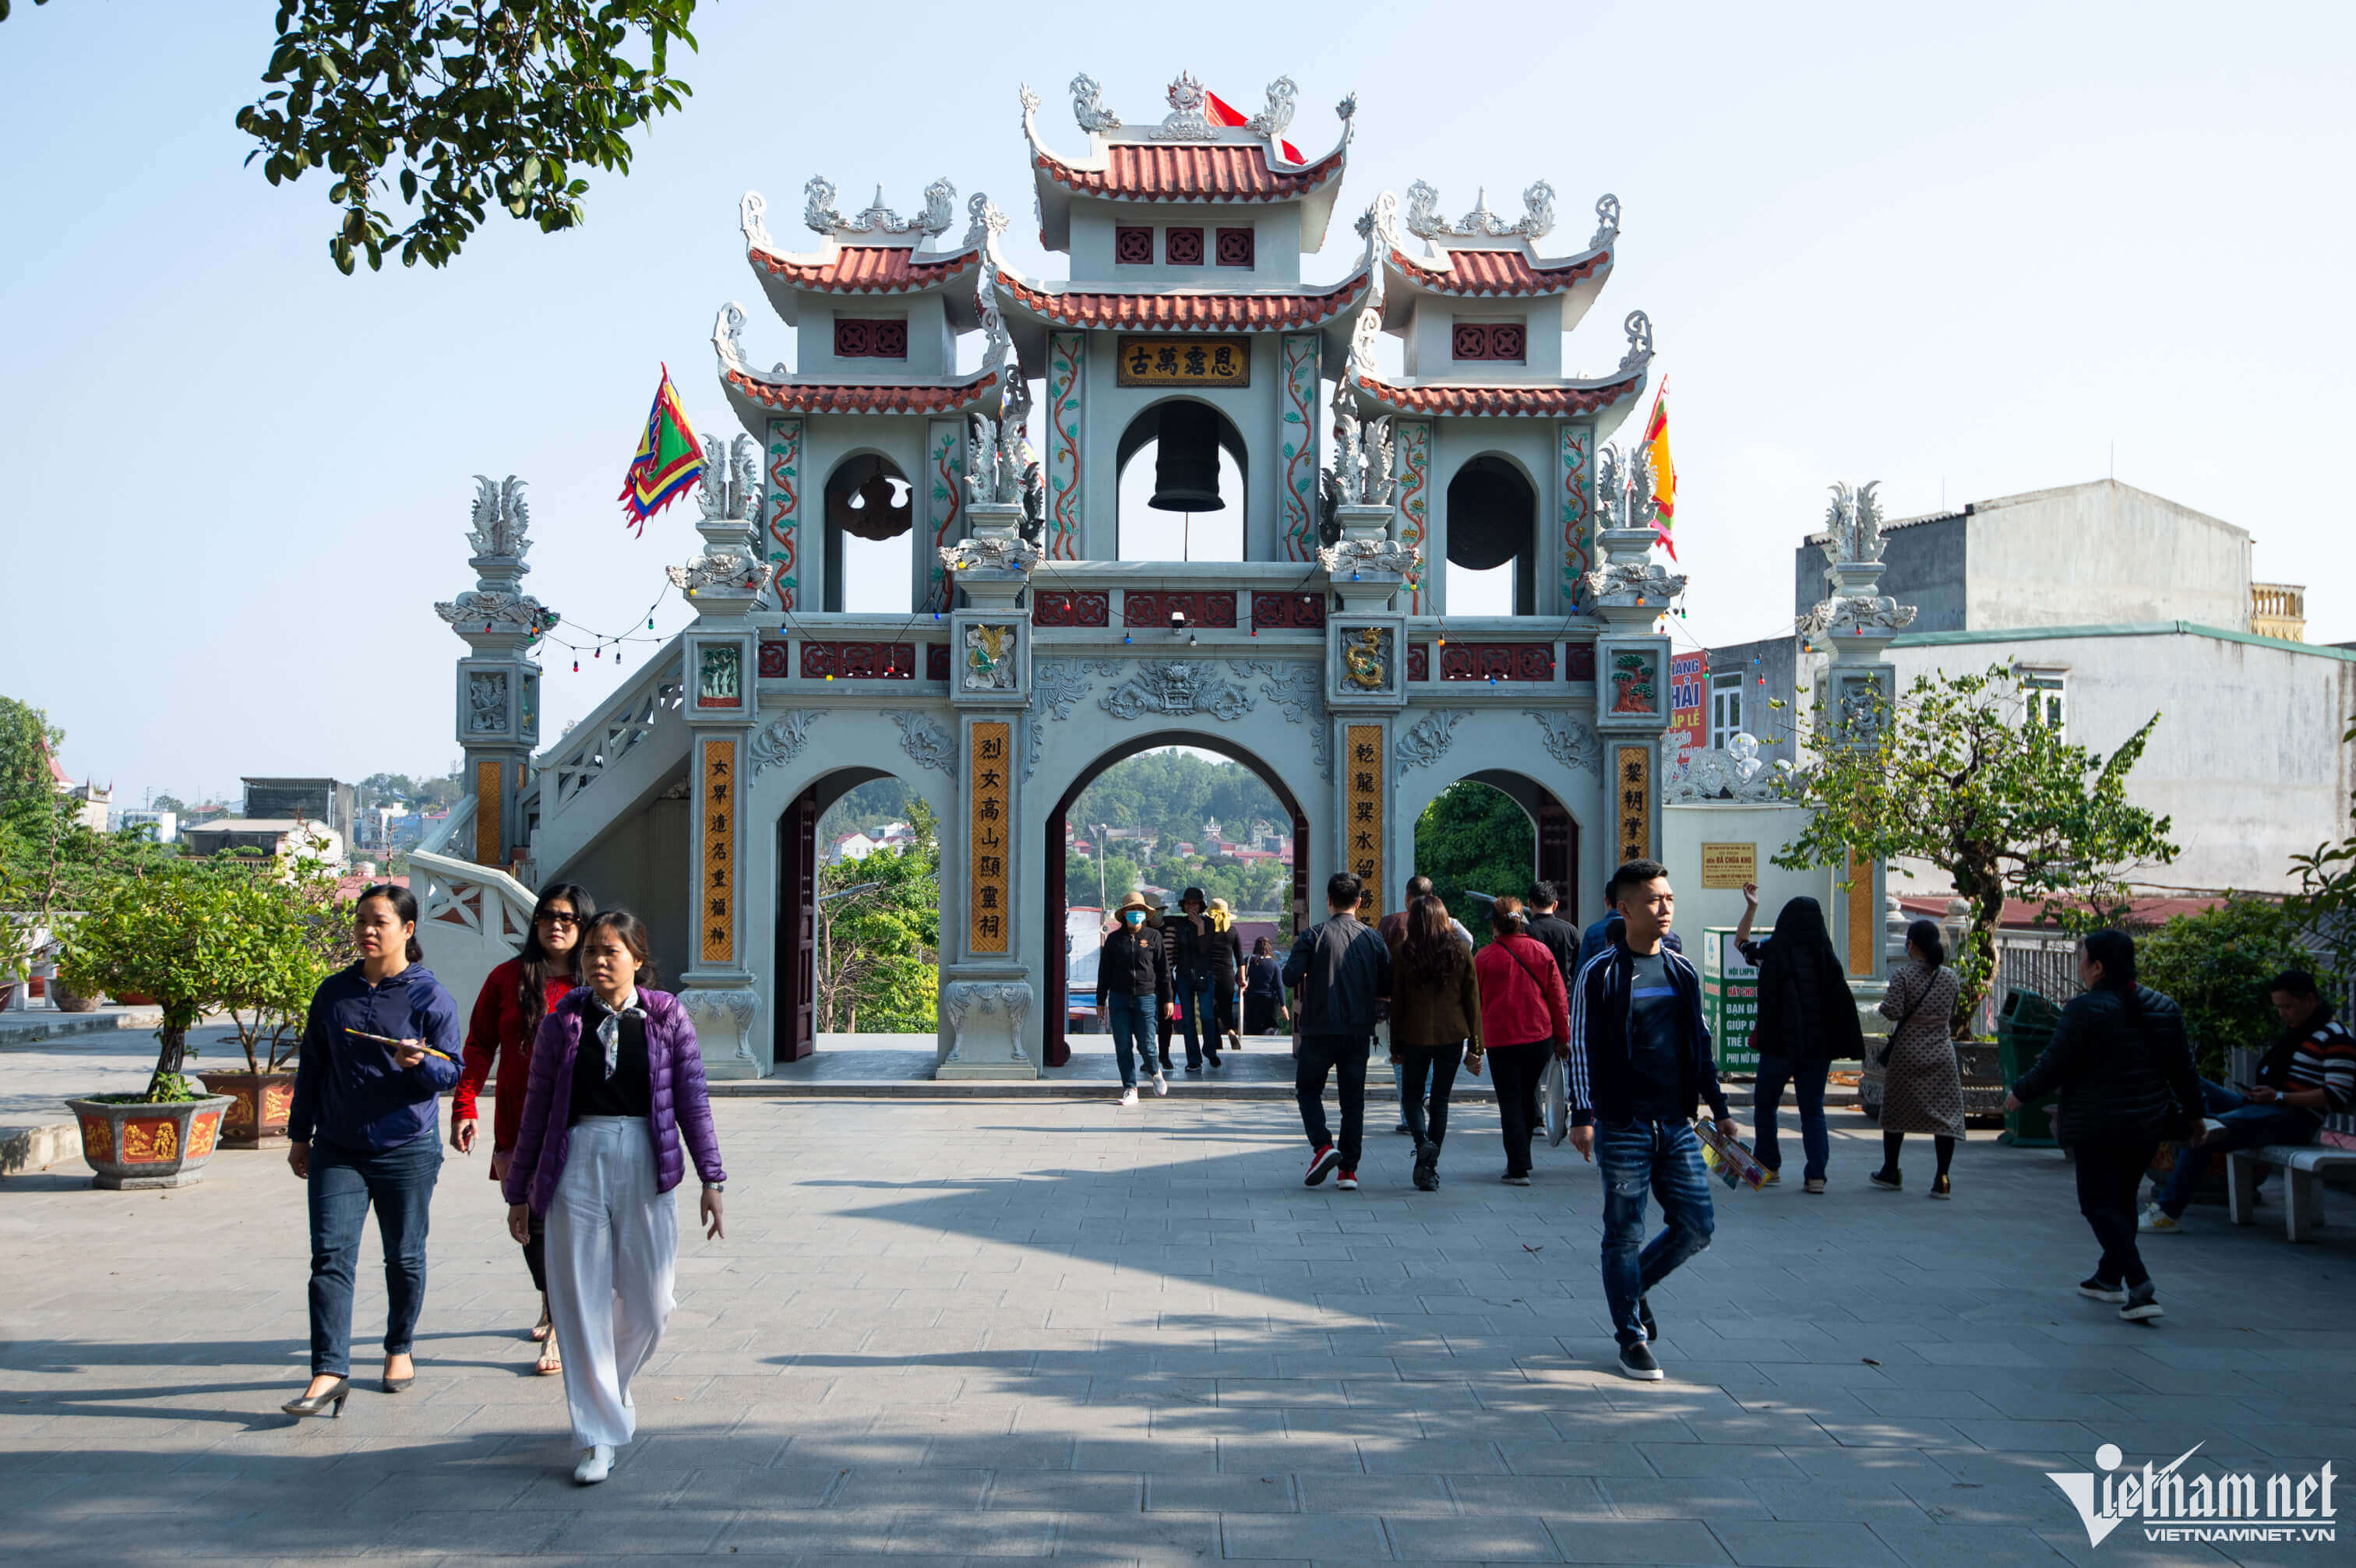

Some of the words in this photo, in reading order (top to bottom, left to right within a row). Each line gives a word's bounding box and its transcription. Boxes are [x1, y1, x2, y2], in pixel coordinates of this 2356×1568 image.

[1688, 708, 1700, 727] LỄ
[1741, 986, 1755, 997] CHO
[1726, 1003, 1744, 1016] BẠN
[1726, 1018, 1747, 1031] GIÚP
[1726, 1034, 1742, 1047] TRẺ
[1726, 1053, 1739, 1066] PHỤ
[1741, 1051, 1751, 1064] NỮ
[1751, 1053, 1761, 1064] NG
